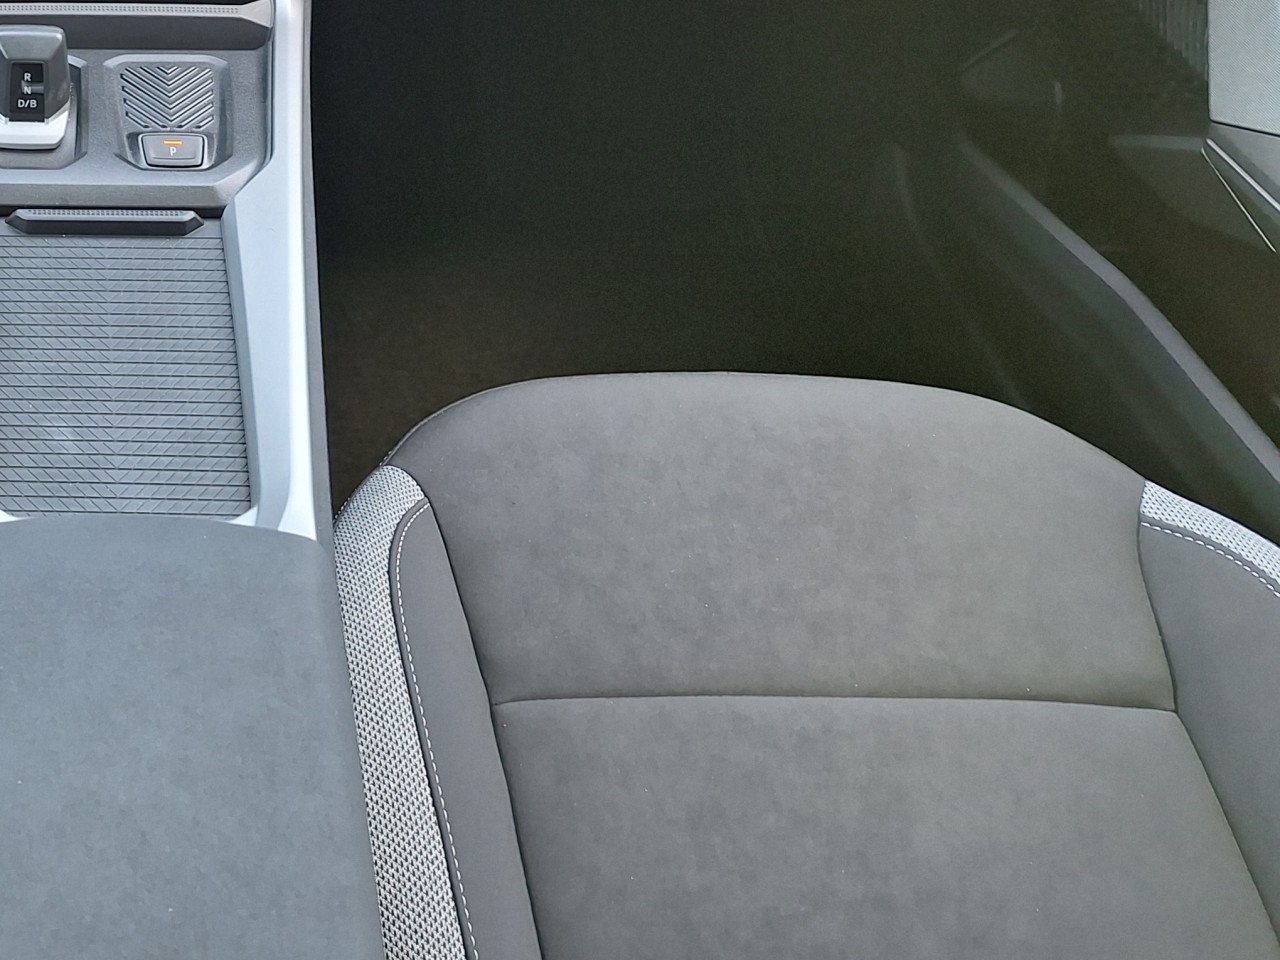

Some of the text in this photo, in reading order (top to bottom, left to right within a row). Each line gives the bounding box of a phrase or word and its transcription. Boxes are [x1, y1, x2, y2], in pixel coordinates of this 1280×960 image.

[24, 72, 32, 82] R
[23, 86, 32, 95] N
[17, 99, 37, 109] D/B
[169, 146, 177, 157] P
